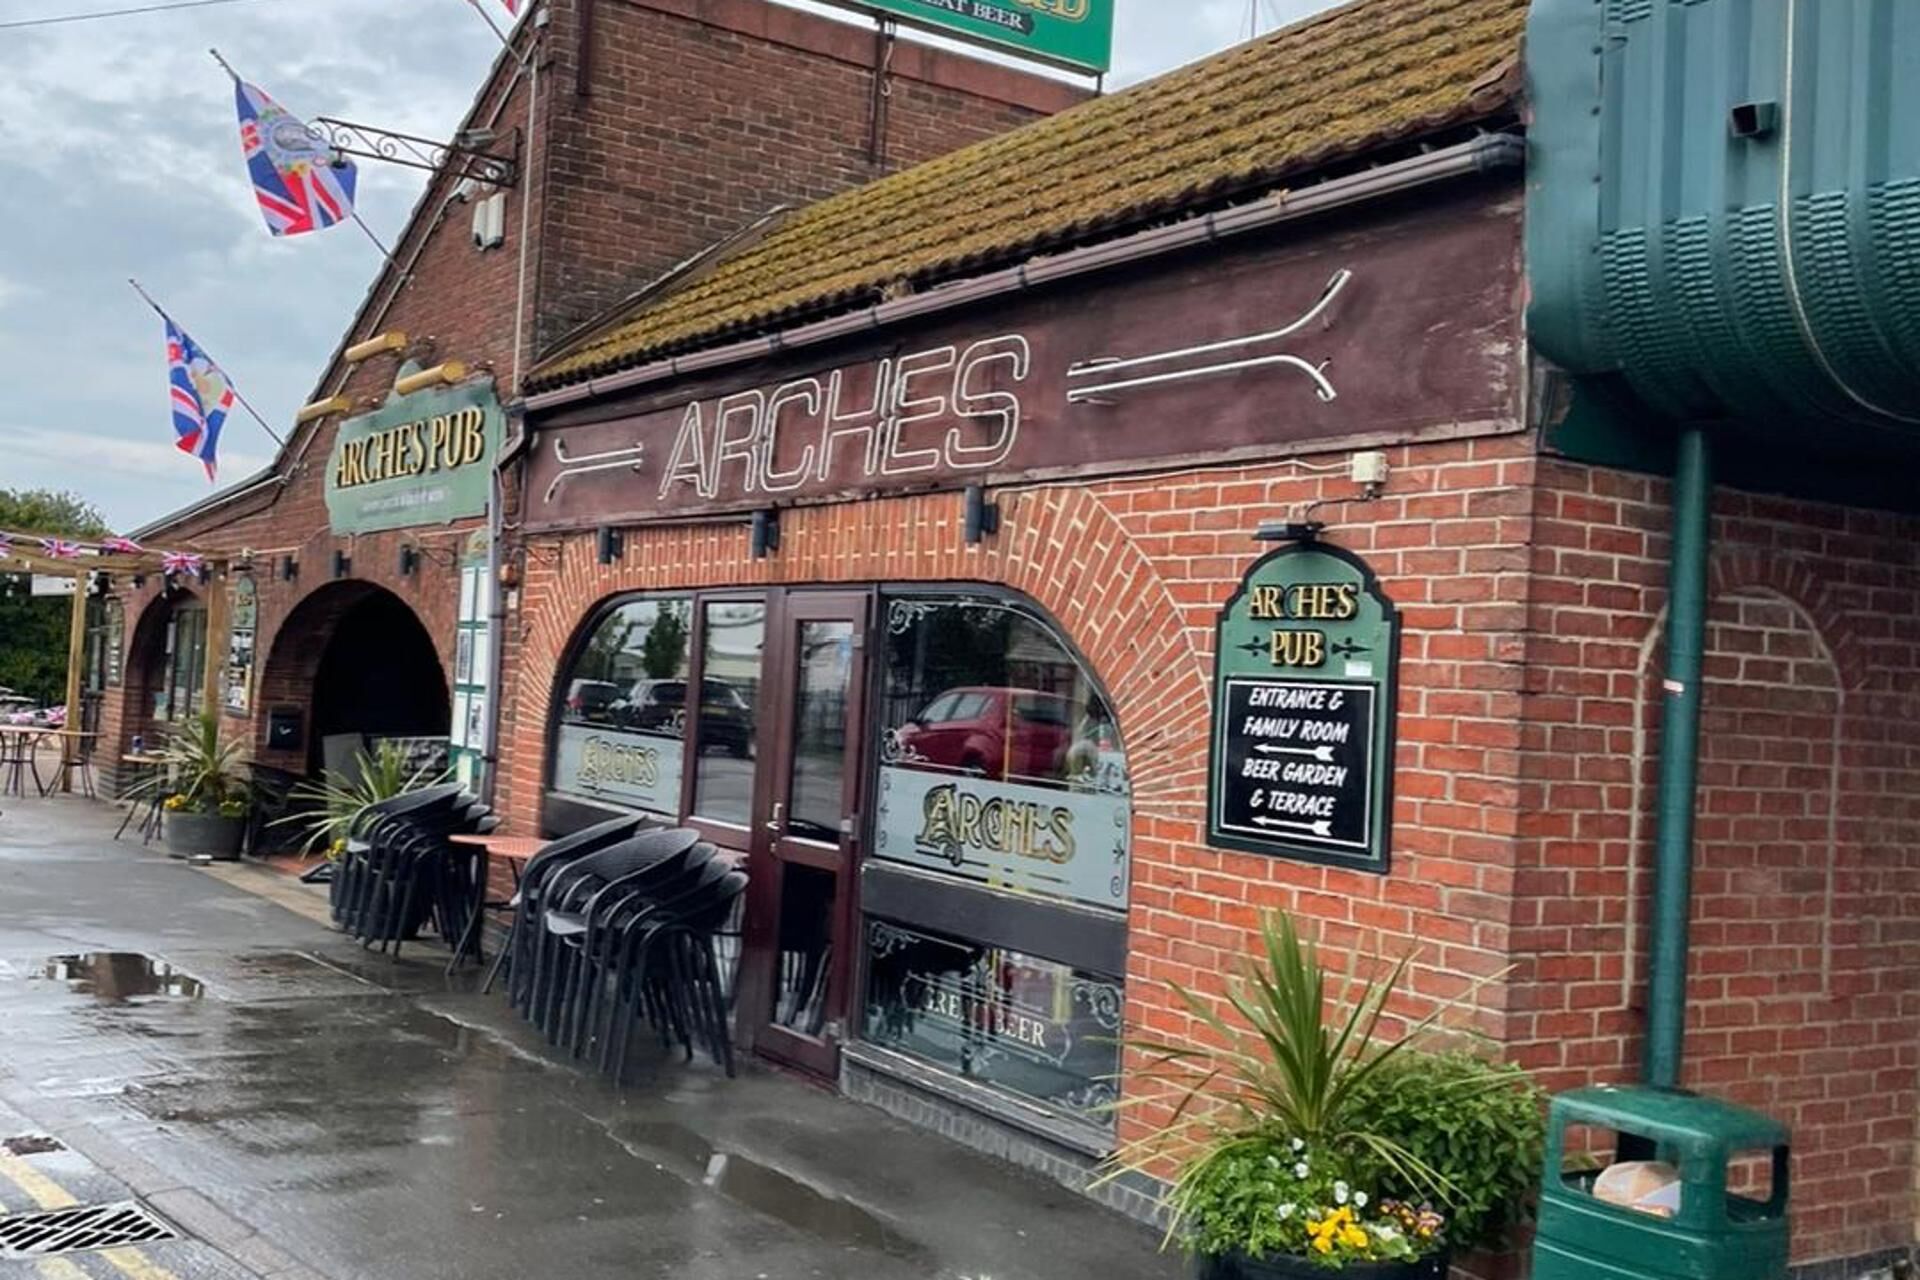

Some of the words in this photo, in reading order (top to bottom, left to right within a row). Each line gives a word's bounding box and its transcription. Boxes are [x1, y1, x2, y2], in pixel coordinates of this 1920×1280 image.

[973, 3, 1025, 30] BEER
[657, 334, 1030, 500] ARCHES
[333, 420, 428, 488] ARCHES
[428, 405, 486, 474] PUB
[1247, 583, 1359, 620] ARCHES
[1270, 629, 1326, 667] PUB
[1248, 687, 1328, 710] ENTRANCE
[1328, 690, 1345, 711] &
[1242, 715, 1300, 739] FAMILY
[1299, 719, 1350, 744] ROOM
[1241, 757, 1281, 782] BEER
[1282, 762, 1348, 788] GARDEN
[1249, 787, 1265, 808] &
[1267, 790, 1337, 817] TERRACE
